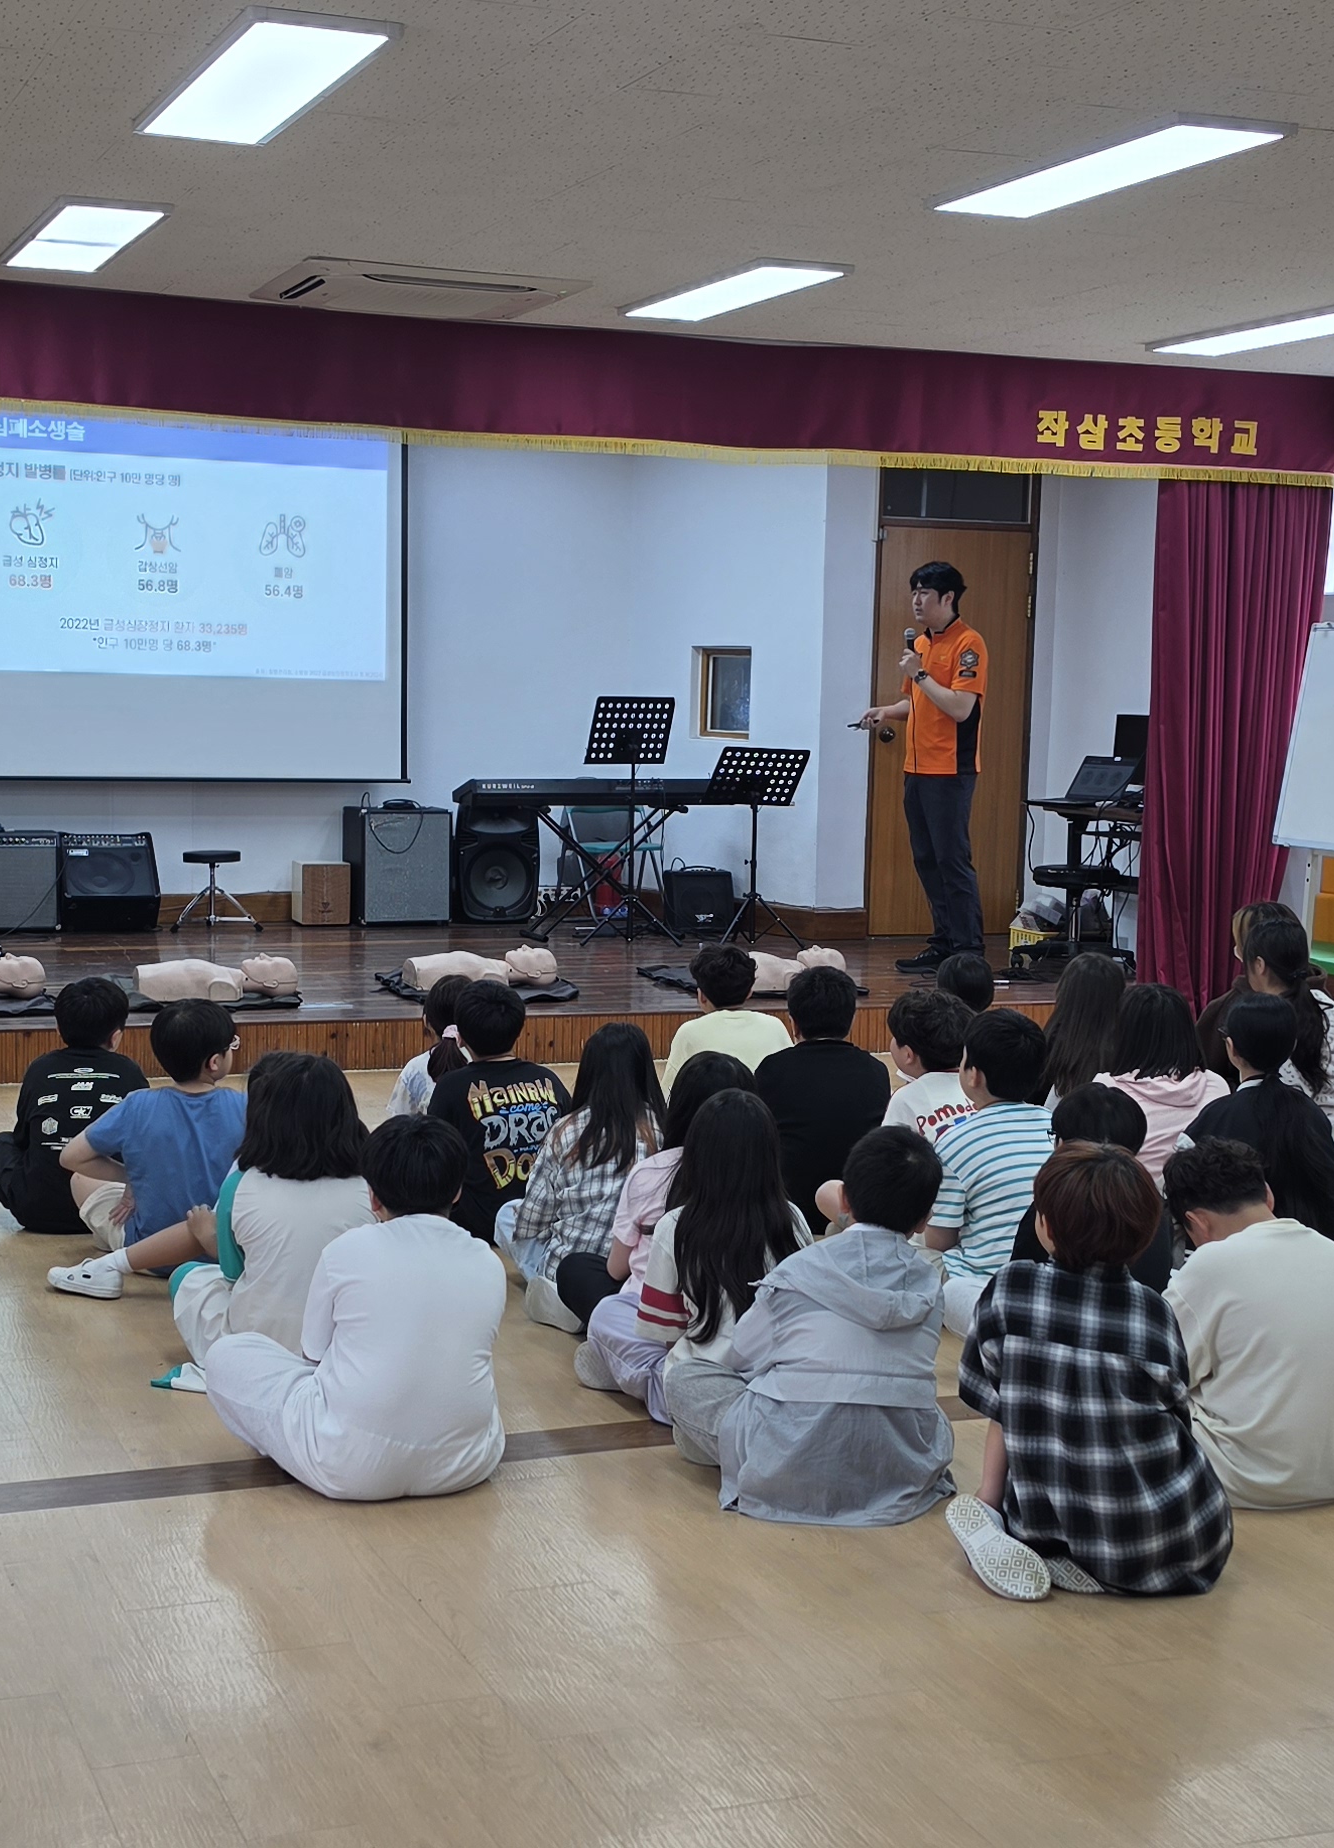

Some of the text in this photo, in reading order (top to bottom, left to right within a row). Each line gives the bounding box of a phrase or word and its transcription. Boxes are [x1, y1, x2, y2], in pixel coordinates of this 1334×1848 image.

[1037, 410, 1258, 456] 좌삼초등학교
[27, 555, 58, 569] 심정지
[137, 560, 178, 574] 갑상선암
[8, 573, 52, 589] 68.3명
[137, 579, 179, 595] 56.8명
[264, 583, 303, 600] 56.4명
[60, 617, 100, 631] 2022년
